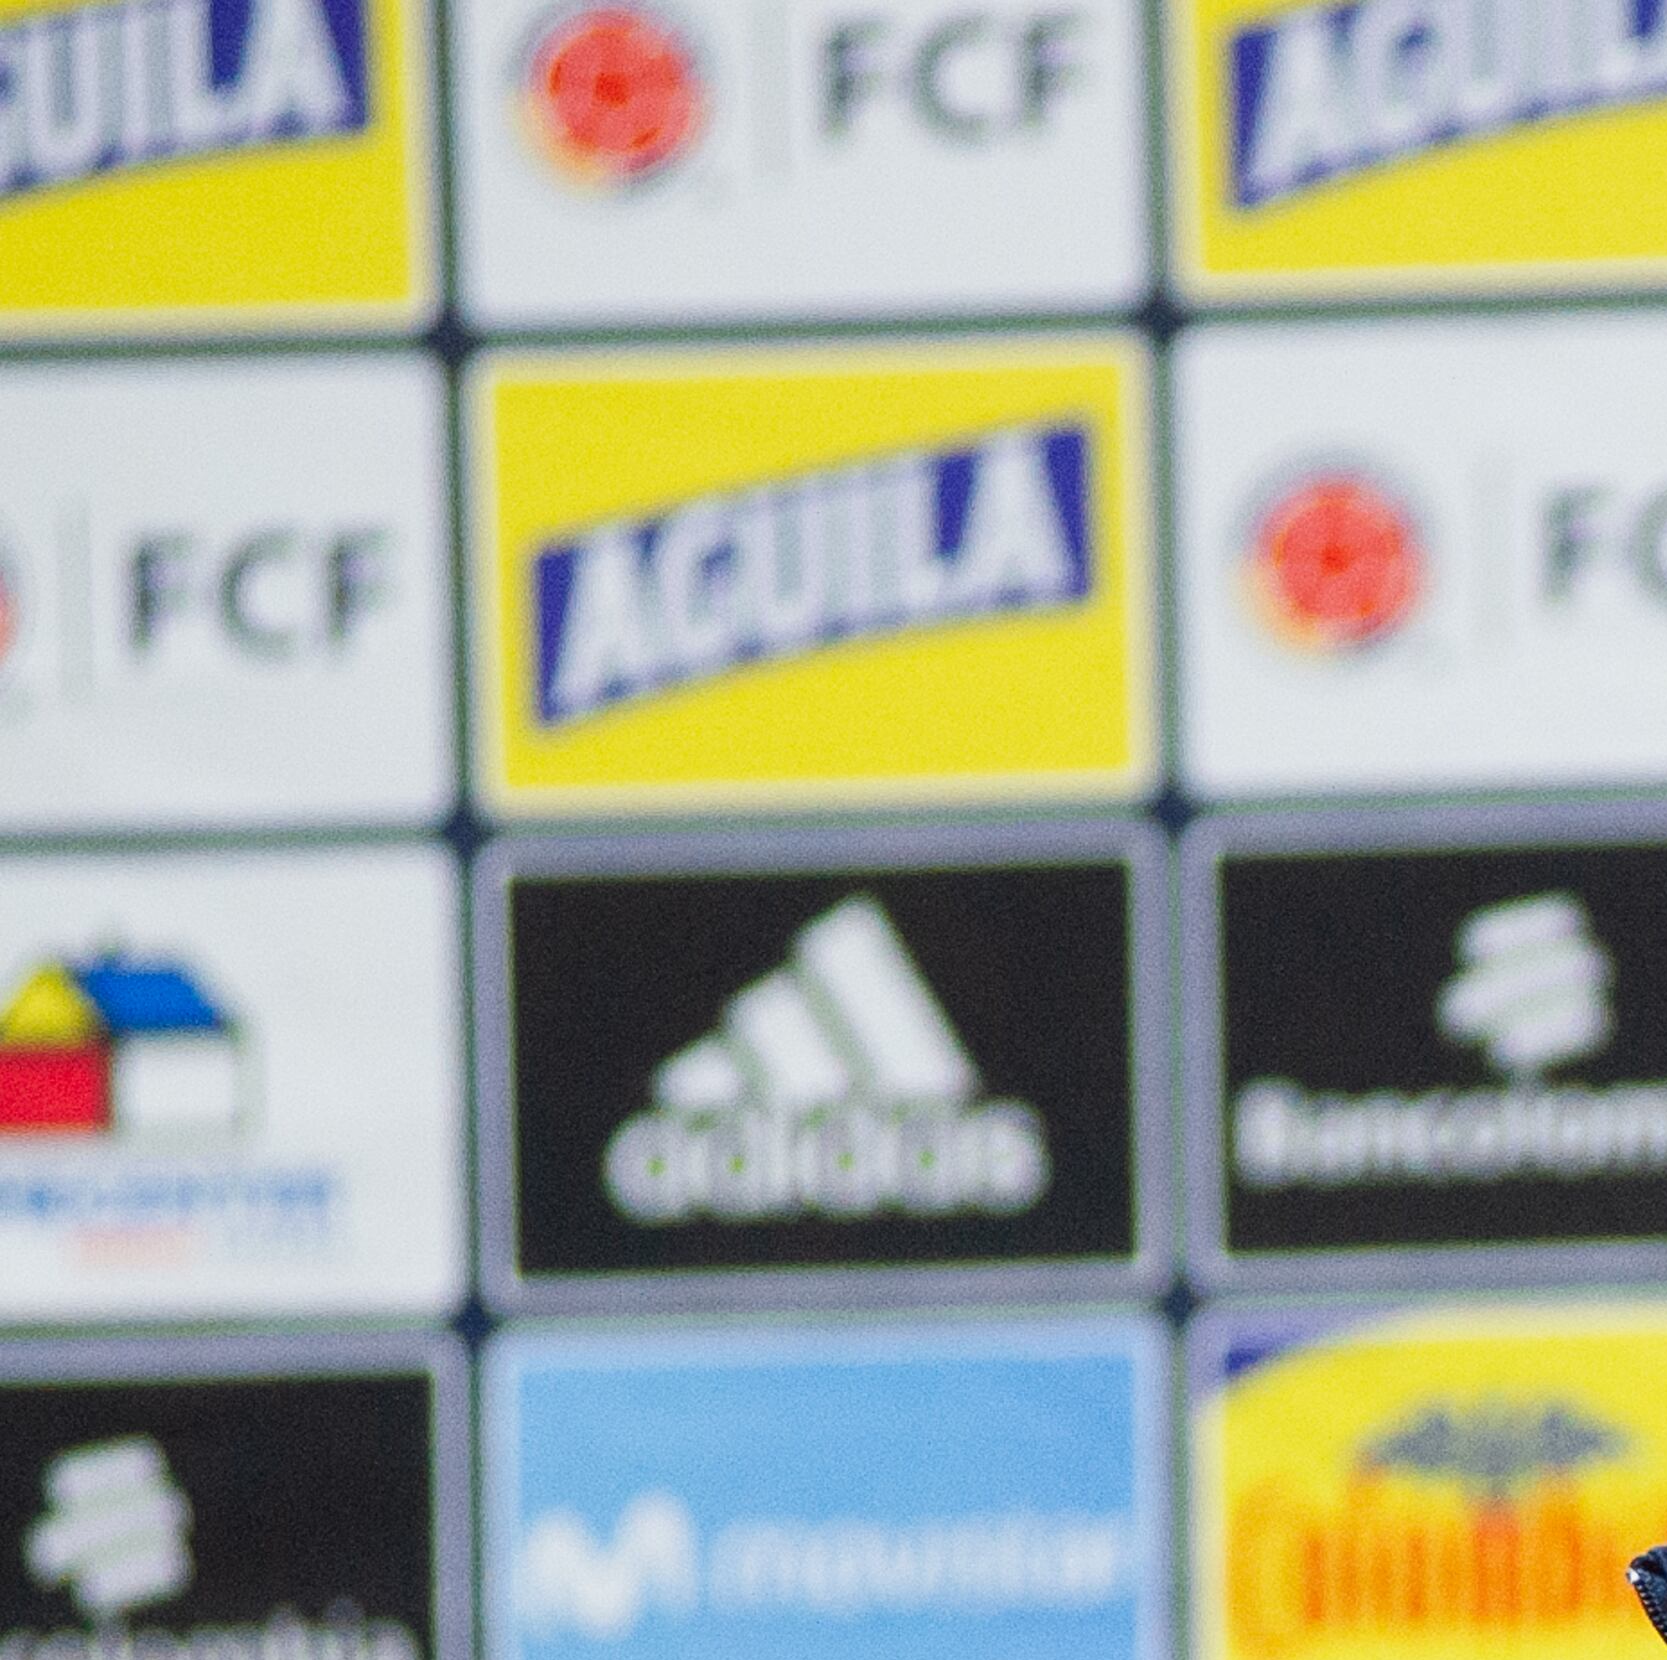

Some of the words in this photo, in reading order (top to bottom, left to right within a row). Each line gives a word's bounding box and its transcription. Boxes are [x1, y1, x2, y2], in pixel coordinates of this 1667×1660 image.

[0, 0, 352, 192] UILA
[820, 12, 1085, 145] FCF
[128, 532, 395, 655] FCF
[545, 428, 1080, 712] AGUILA
[606, 1098, 1048, 1222] adidas
